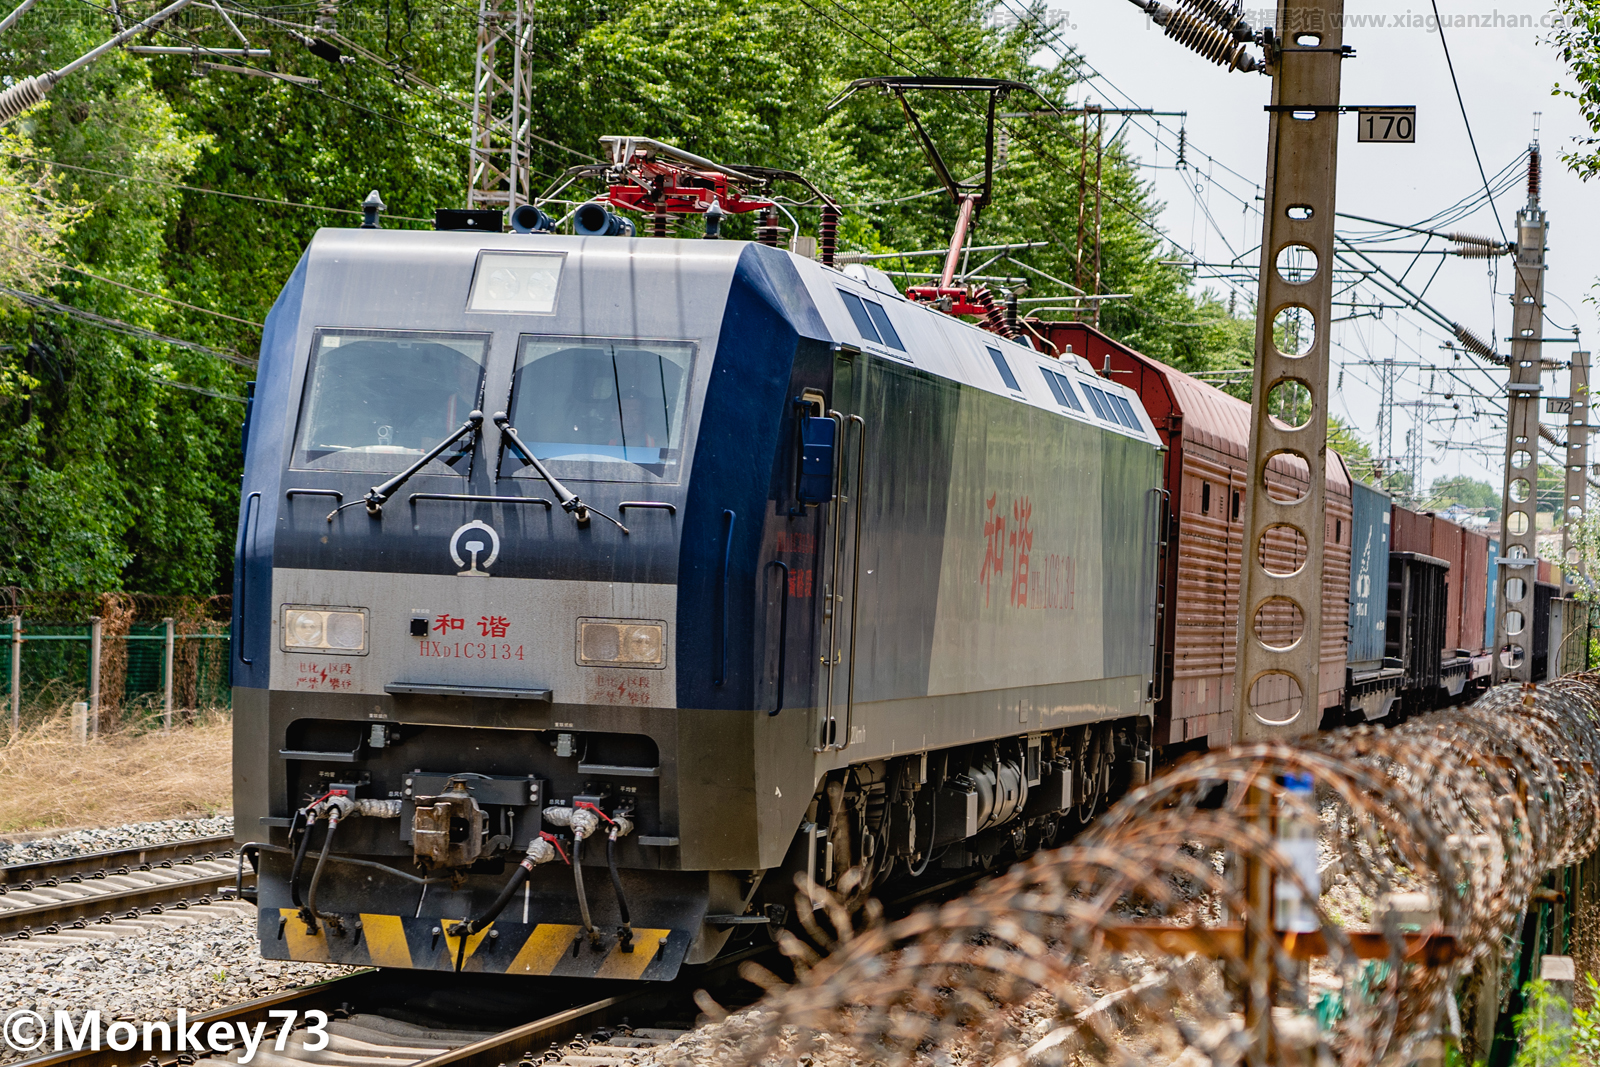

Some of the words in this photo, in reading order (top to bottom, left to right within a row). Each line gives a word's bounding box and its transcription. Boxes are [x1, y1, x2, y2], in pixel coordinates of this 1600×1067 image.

[1366, 115, 1412, 139] 170
[1550, 401, 1571, 413] 172
[979, 490, 1034, 610] 和谐
[432, 613, 511, 638] 和谐
[419, 640, 525, 660] HXD1C3134
